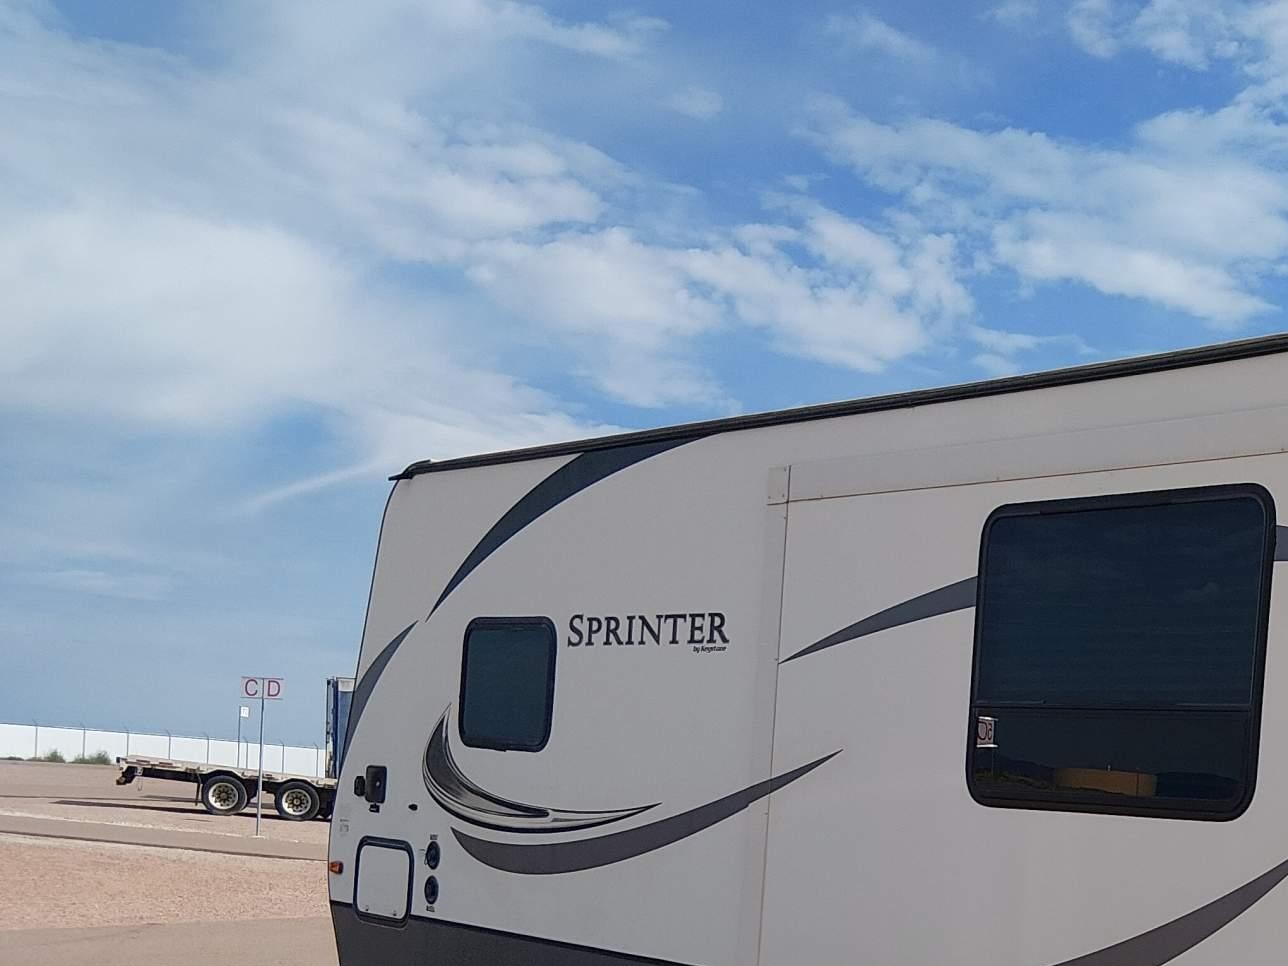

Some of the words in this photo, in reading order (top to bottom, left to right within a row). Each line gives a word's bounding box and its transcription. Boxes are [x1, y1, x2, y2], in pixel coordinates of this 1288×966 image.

[567, 613, 729, 647] SPRINTER
[245, 679, 258, 696] C
[267, 680, 281, 697] D
